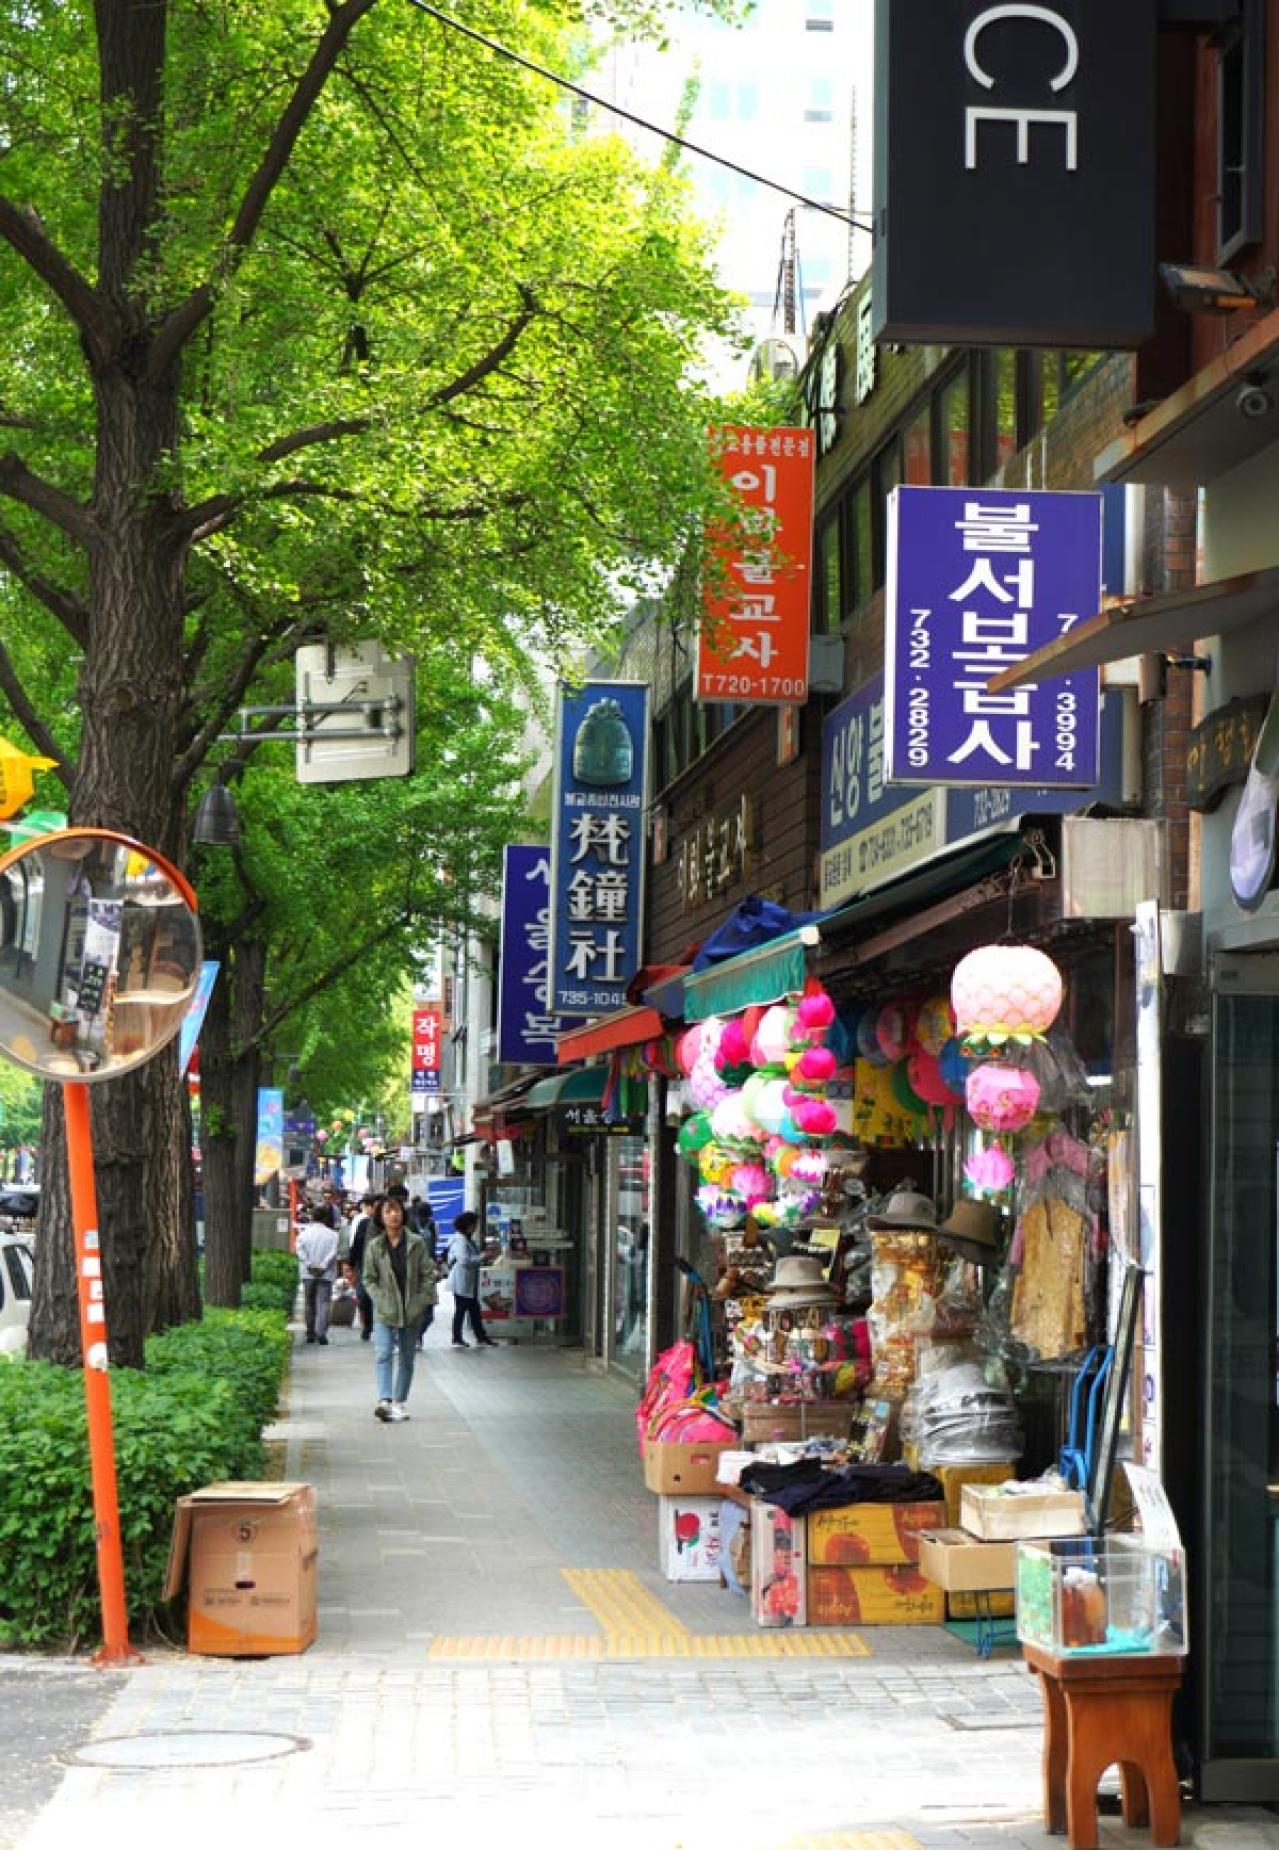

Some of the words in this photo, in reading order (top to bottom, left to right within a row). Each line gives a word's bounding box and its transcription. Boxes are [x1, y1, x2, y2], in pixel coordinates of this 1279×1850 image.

[702, 675, 806, 696] T720-1700
[946, 502, 1042, 771] 불서보급사
[566, 812, 631, 984] 梵鐘社
[415, 1017, 439, 1066] 작명
